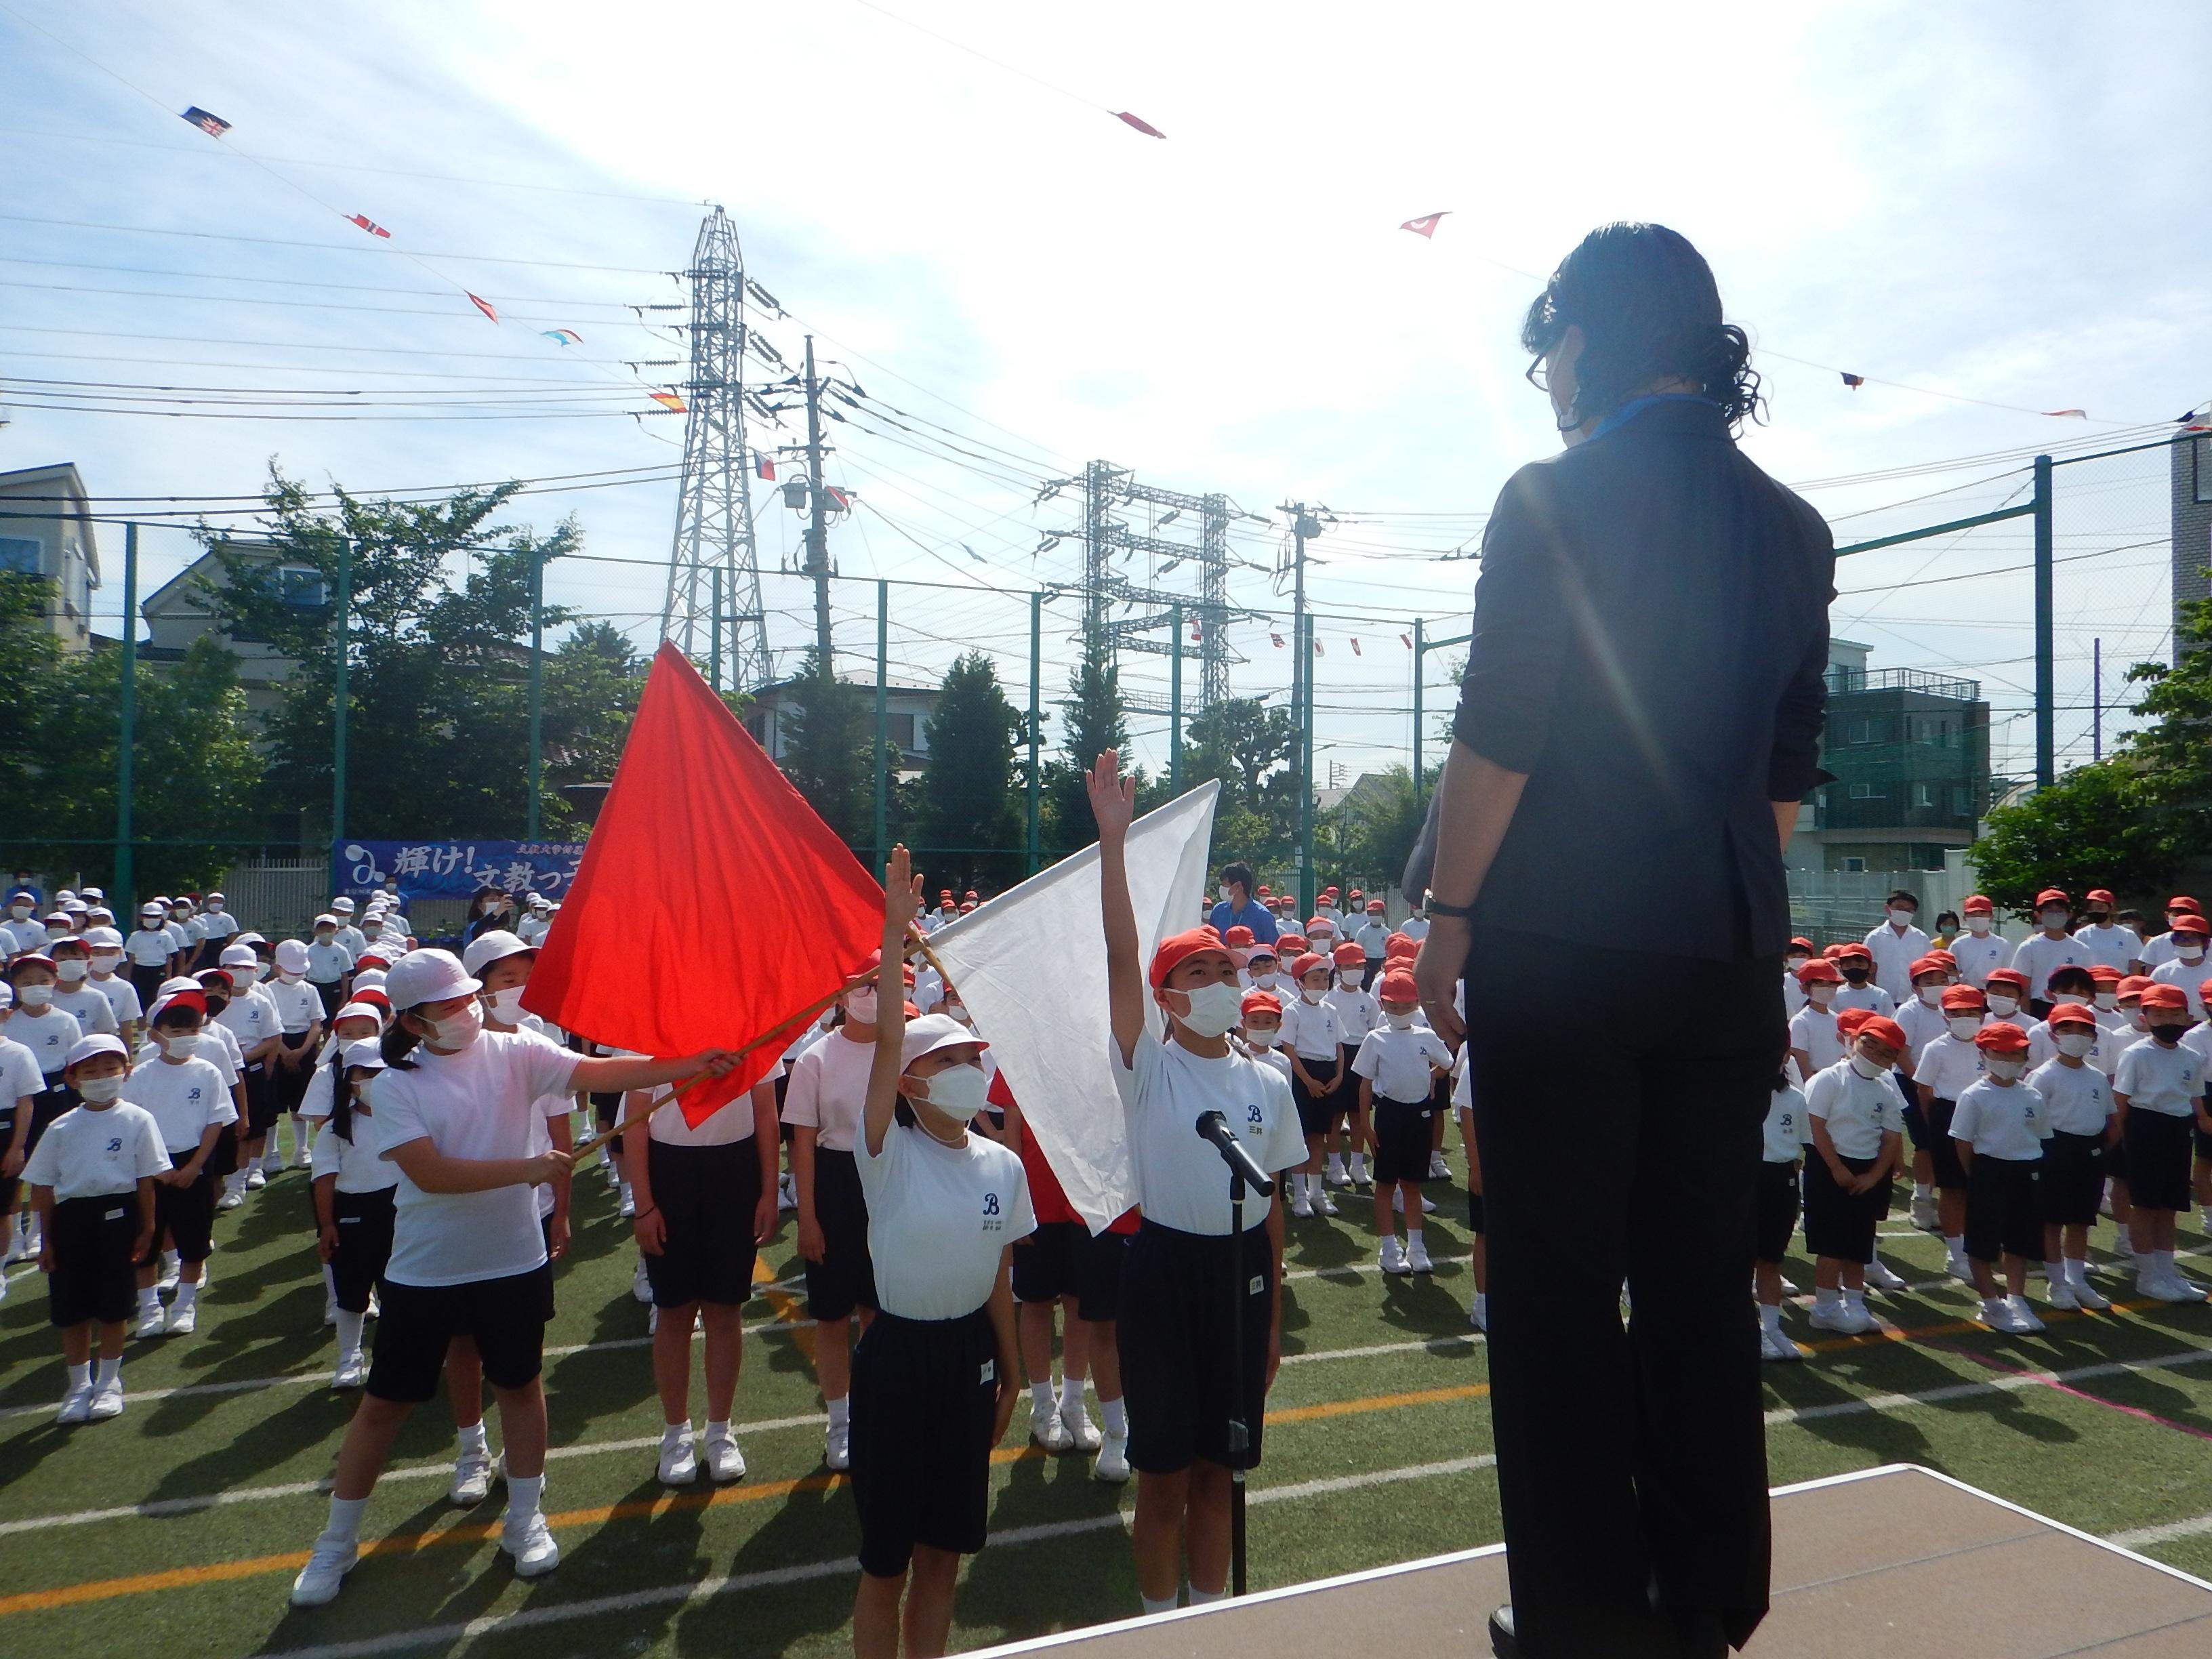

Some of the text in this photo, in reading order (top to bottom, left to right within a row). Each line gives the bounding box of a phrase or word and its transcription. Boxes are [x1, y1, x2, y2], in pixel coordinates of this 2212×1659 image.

[1247, 1105, 1263, 1123] B
[106, 1138, 123, 1151] B
[983, 1193, 1000, 1216] B
